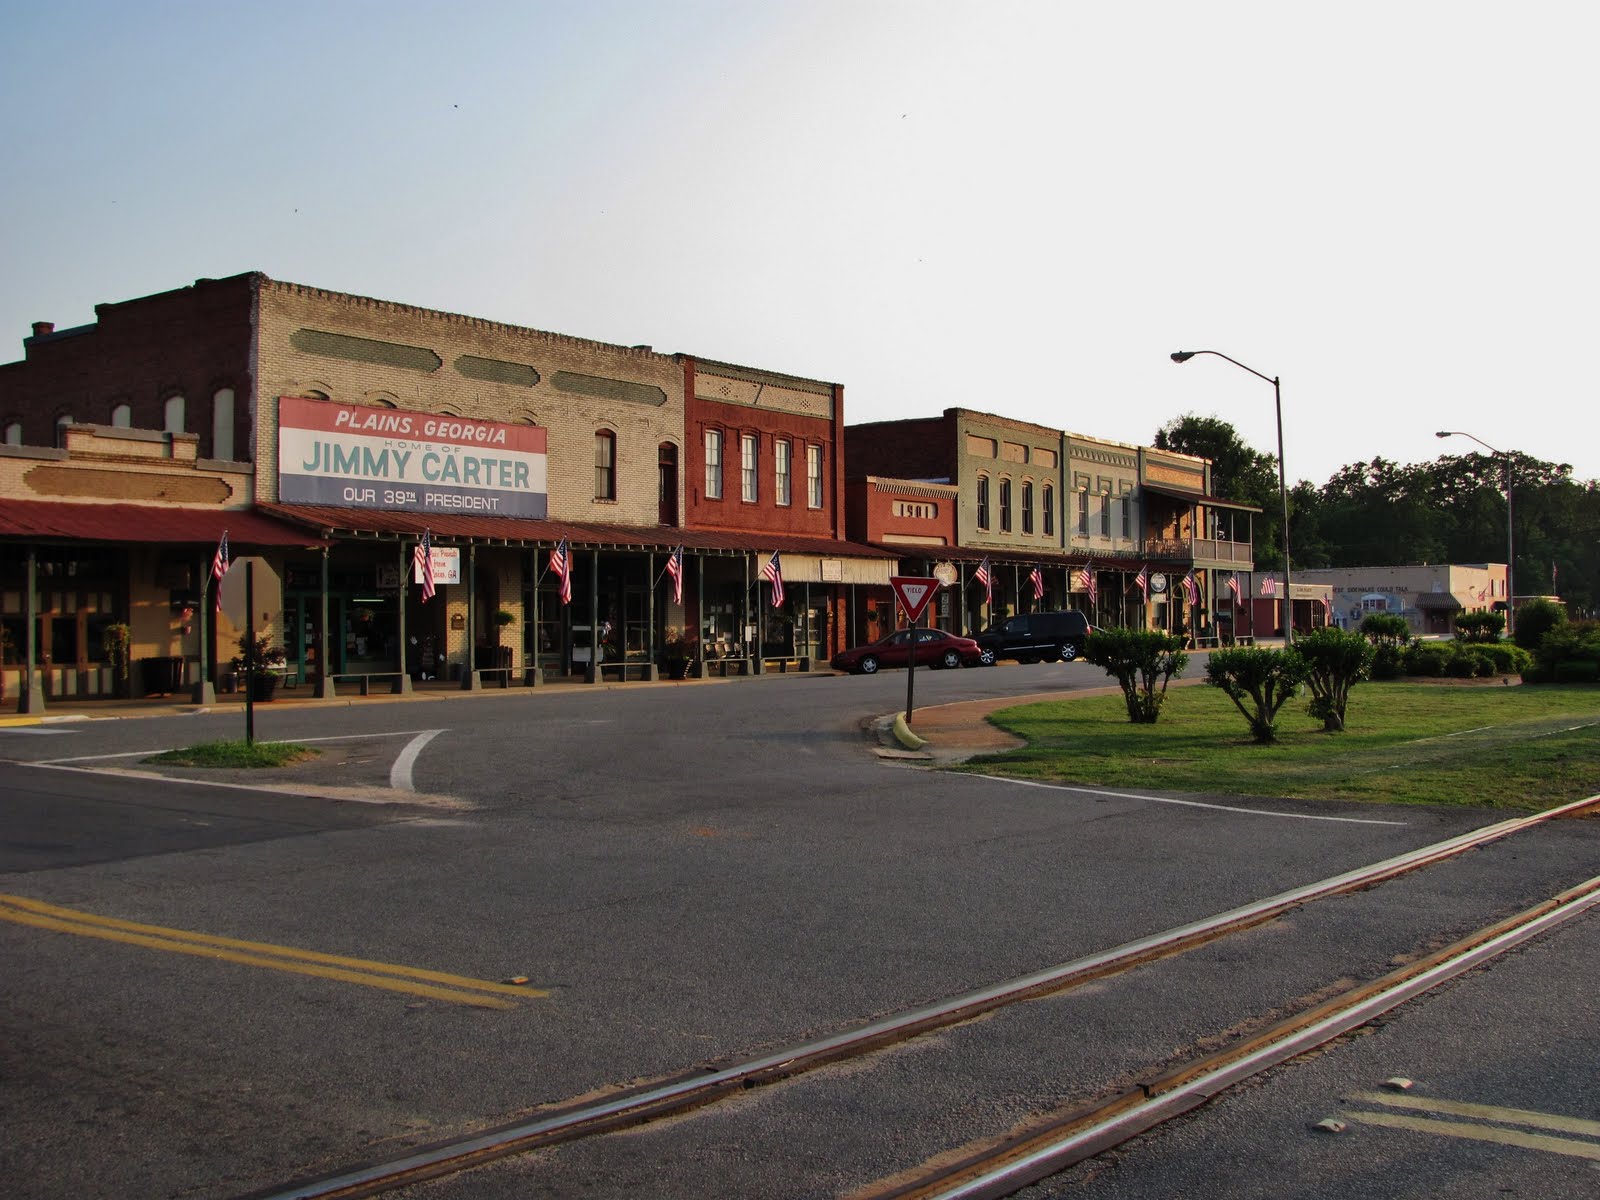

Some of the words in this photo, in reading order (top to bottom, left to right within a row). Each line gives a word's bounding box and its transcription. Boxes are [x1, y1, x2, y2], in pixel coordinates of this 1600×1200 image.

[335, 410, 419, 437] PLAINS,
[424, 420, 506, 444] GEORGIA
[384, 440, 433, 451] HOME
[441, 445, 461, 454] OF
[303, 441, 412, 479] JIMMY
[421, 451, 530, 489] CARTER
[343, 487, 376, 502] OUR
[384, 489, 417, 505] 39TH
[425, 492, 500, 510] PRESIDENT
[900, 503, 929, 518] 1901
[447, 569, 457, 579] GA
